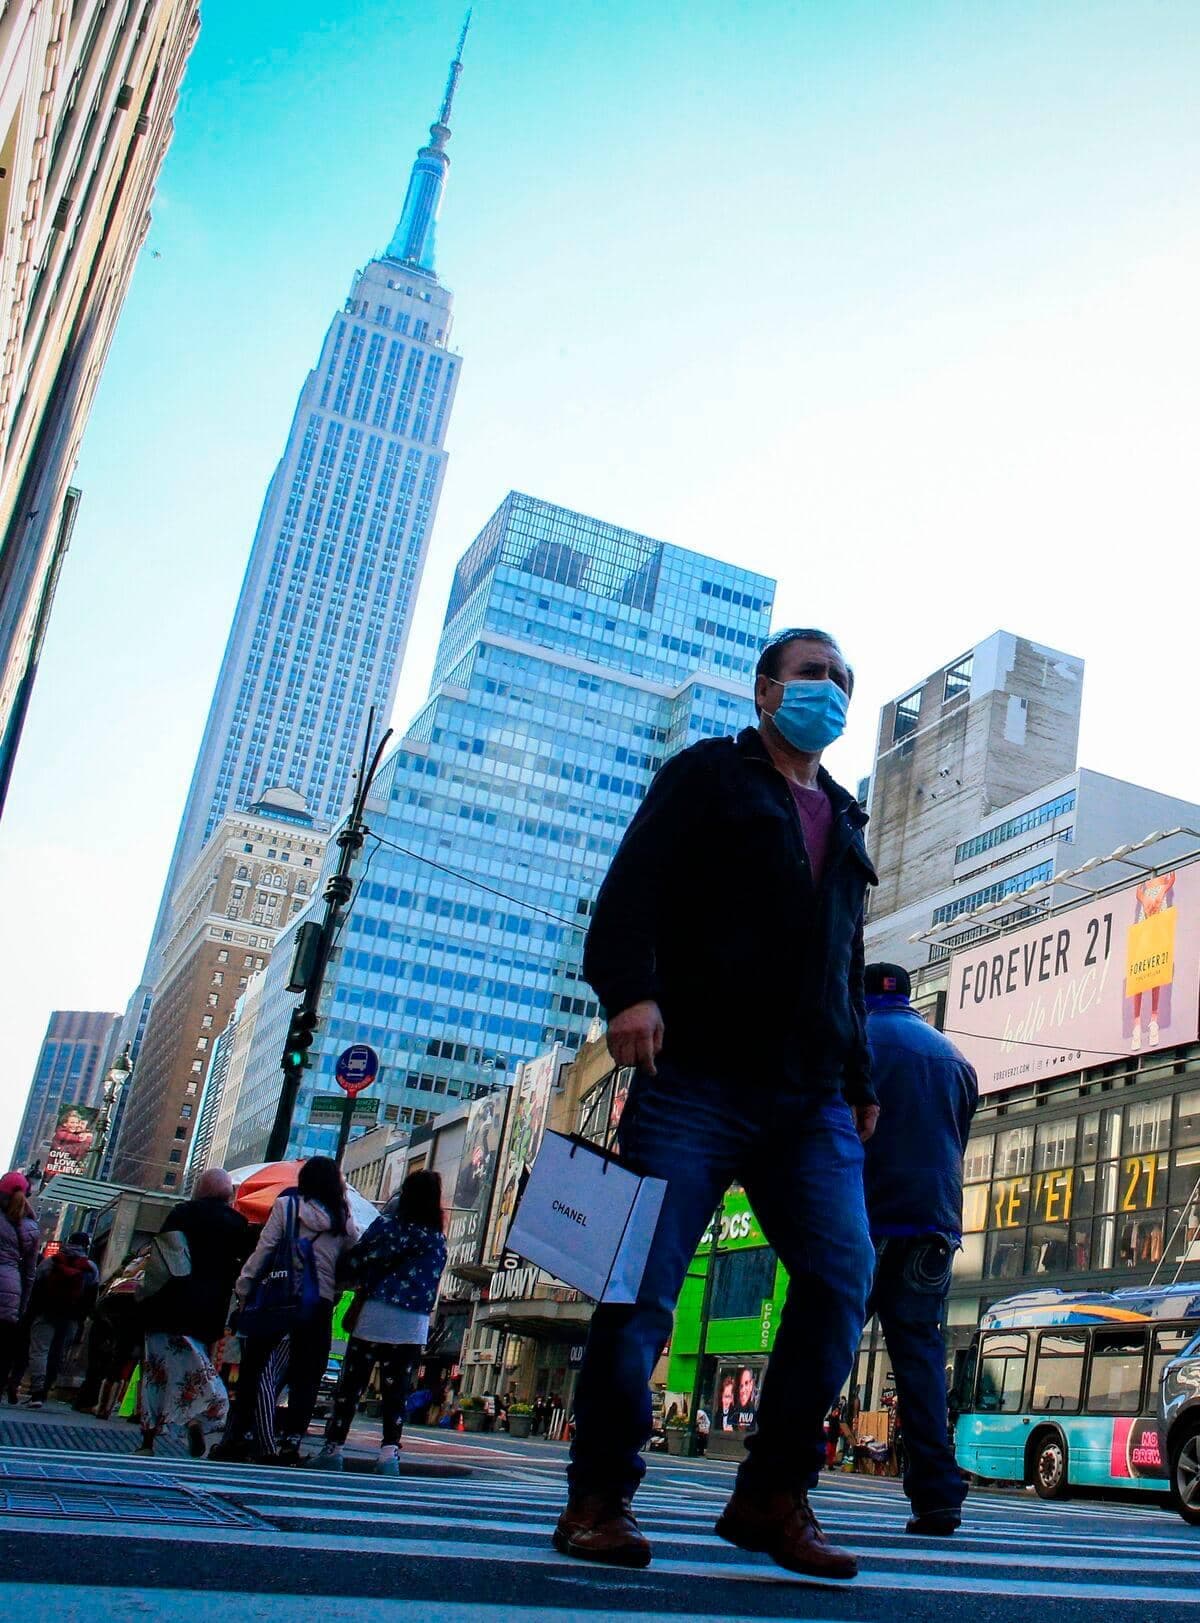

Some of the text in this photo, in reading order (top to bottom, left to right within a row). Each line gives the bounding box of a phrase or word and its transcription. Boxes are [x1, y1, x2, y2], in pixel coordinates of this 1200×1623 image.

[959, 912, 1113, 1009] FOREVER 21
[1129, 954, 1160, 976] FOREVER
[1161, 951, 1169, 965] 21
[1000, 950, 1110, 1054] hello NYC!
[1123, 1153, 1159, 1211] 21
[552, 1200, 587, 1227] CHANEL
[504, 1266, 540, 1299] NAVY
